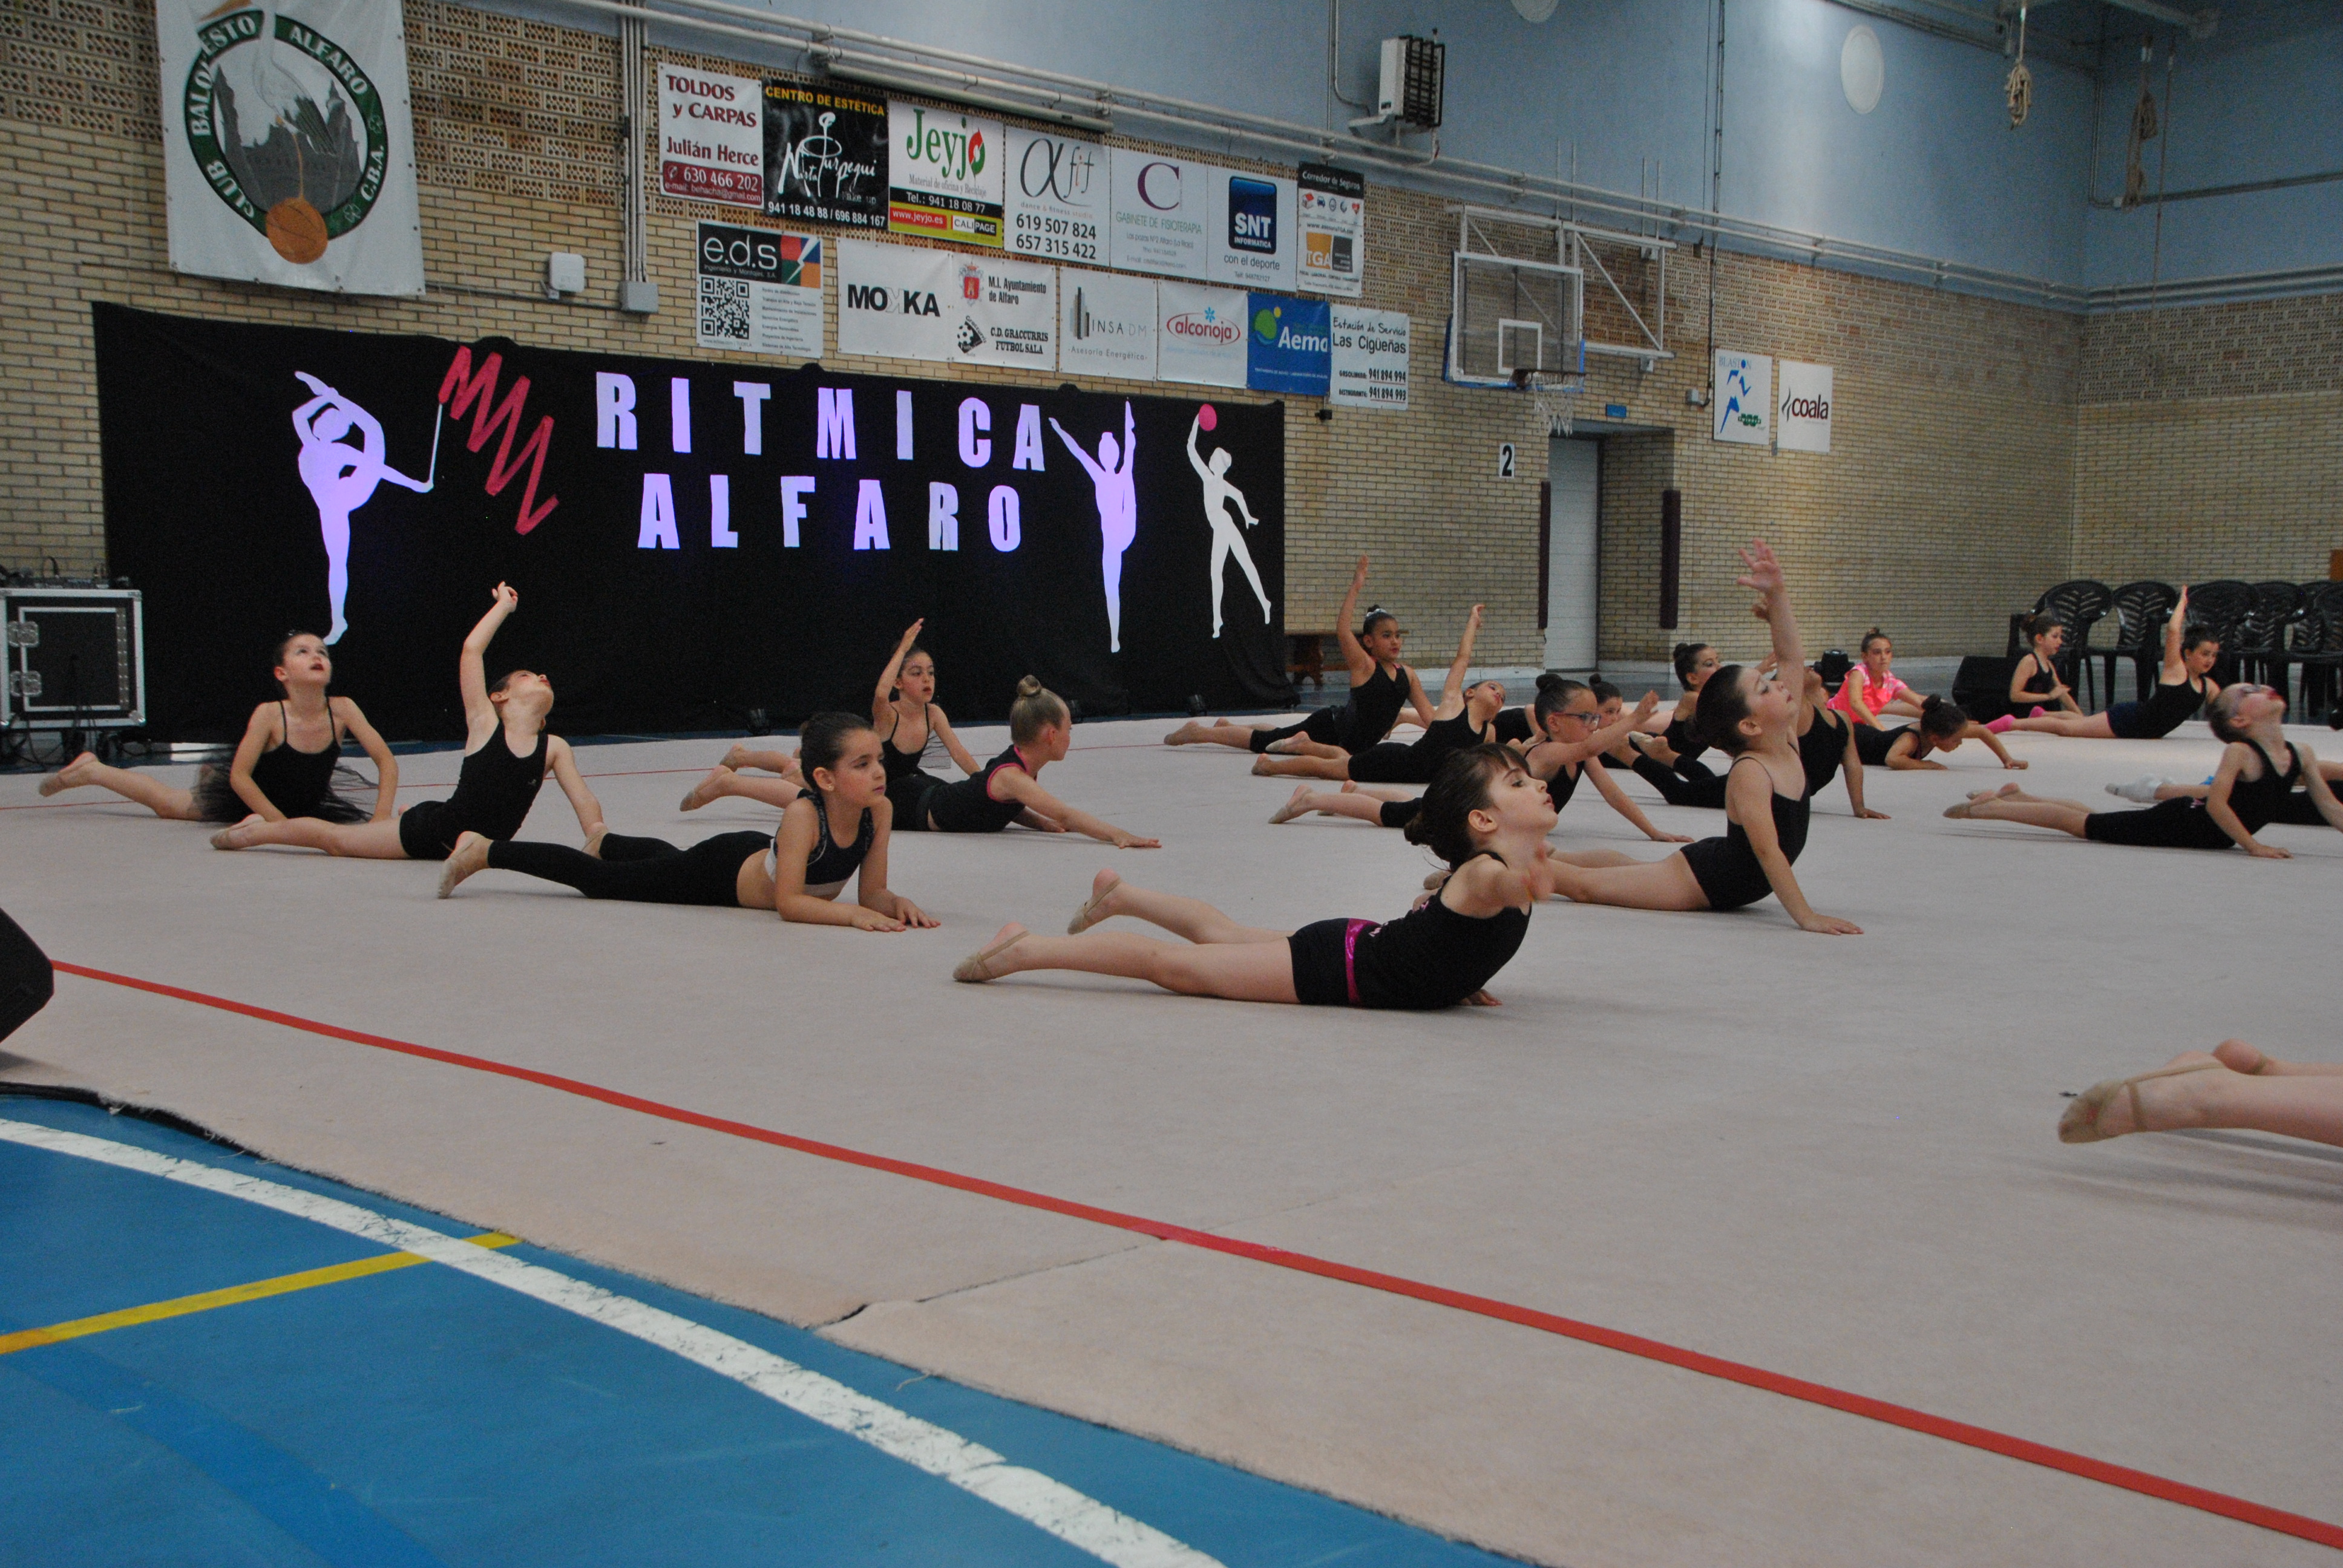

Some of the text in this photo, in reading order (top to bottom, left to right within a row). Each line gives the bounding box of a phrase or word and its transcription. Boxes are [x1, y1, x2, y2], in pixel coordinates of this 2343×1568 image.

[289, 24, 368, 95] ALFARO
[666, 75, 735, 101] TOLDOS
[765, 87, 814, 103] CENTRO
[817, 94, 831, 106] DE
[190, 15, 257, 218] CLUB BALOESTO
[673, 102, 757, 128] y CARPAS
[667, 136, 759, 166] Julián Herce
[906, 108, 986, 181] Jeyjo
[684, 167, 758, 192] 630 466 202
[909, 174, 932, 188] Material
[934, 179, 940, 188] de
[942, 180, 958, 192] oficina
[1138, 162, 1179, 211] C
[1302, 171, 1331, 184] Corredor
[1340, 178, 1360, 191] Seguros
[768, 201, 785, 214] 941
[789, 204, 801, 215] 18
[804, 206, 815, 217] 48
[818, 208, 828, 219] 88
[835, 209, 850, 221] 696
[852, 212, 868, 224] 884
[870, 215, 885, 227] 167
[906, 192, 985, 214] Tel.: 941 18 08 77
[1021, 201, 1040, 210] dance
[1049, 206, 1070, 215] fitness
[893, 210, 943, 224] www.jeyjo.es
[1017, 214, 1096, 240] 619 507 824
[1116, 211, 1202, 234] GABINETE DE FISIOTERAPIA
[1234, 212, 1271, 238] SNT
[1017, 234, 1096, 260] 657 315 422
[1307, 250, 1331, 266] TGA
[1224, 255, 1280, 270] con el deporte
[989, 290, 1019, 305] de Alfaro
[1004, 278, 1046, 294] Ayuntamiento
[991, 327, 1048, 341] C.D. GRACCURRIS
[1333, 317, 1364, 331] Estación
[1368, 322, 1375, 333] de
[1378, 322, 1406, 336] Servicio
[995, 341, 1043, 354] FUTBOL SALA
[1332, 333, 1406, 354] Las Cigüeñas
[1369, 368, 1380, 380] 941
[1381, 368, 1392, 381] 894
[1394, 370, 1406, 382] 994
[1369, 386, 1380, 399] 941
[1381, 387, 1394, 400] 894
[1395, 388, 1406, 401] 993
[1792, 394, 1829, 420] coala
[596, 371, 1046, 472] RITMICA
[1502, 445, 1512, 477] 2
[637, 472, 1021, 552] ALFARO
